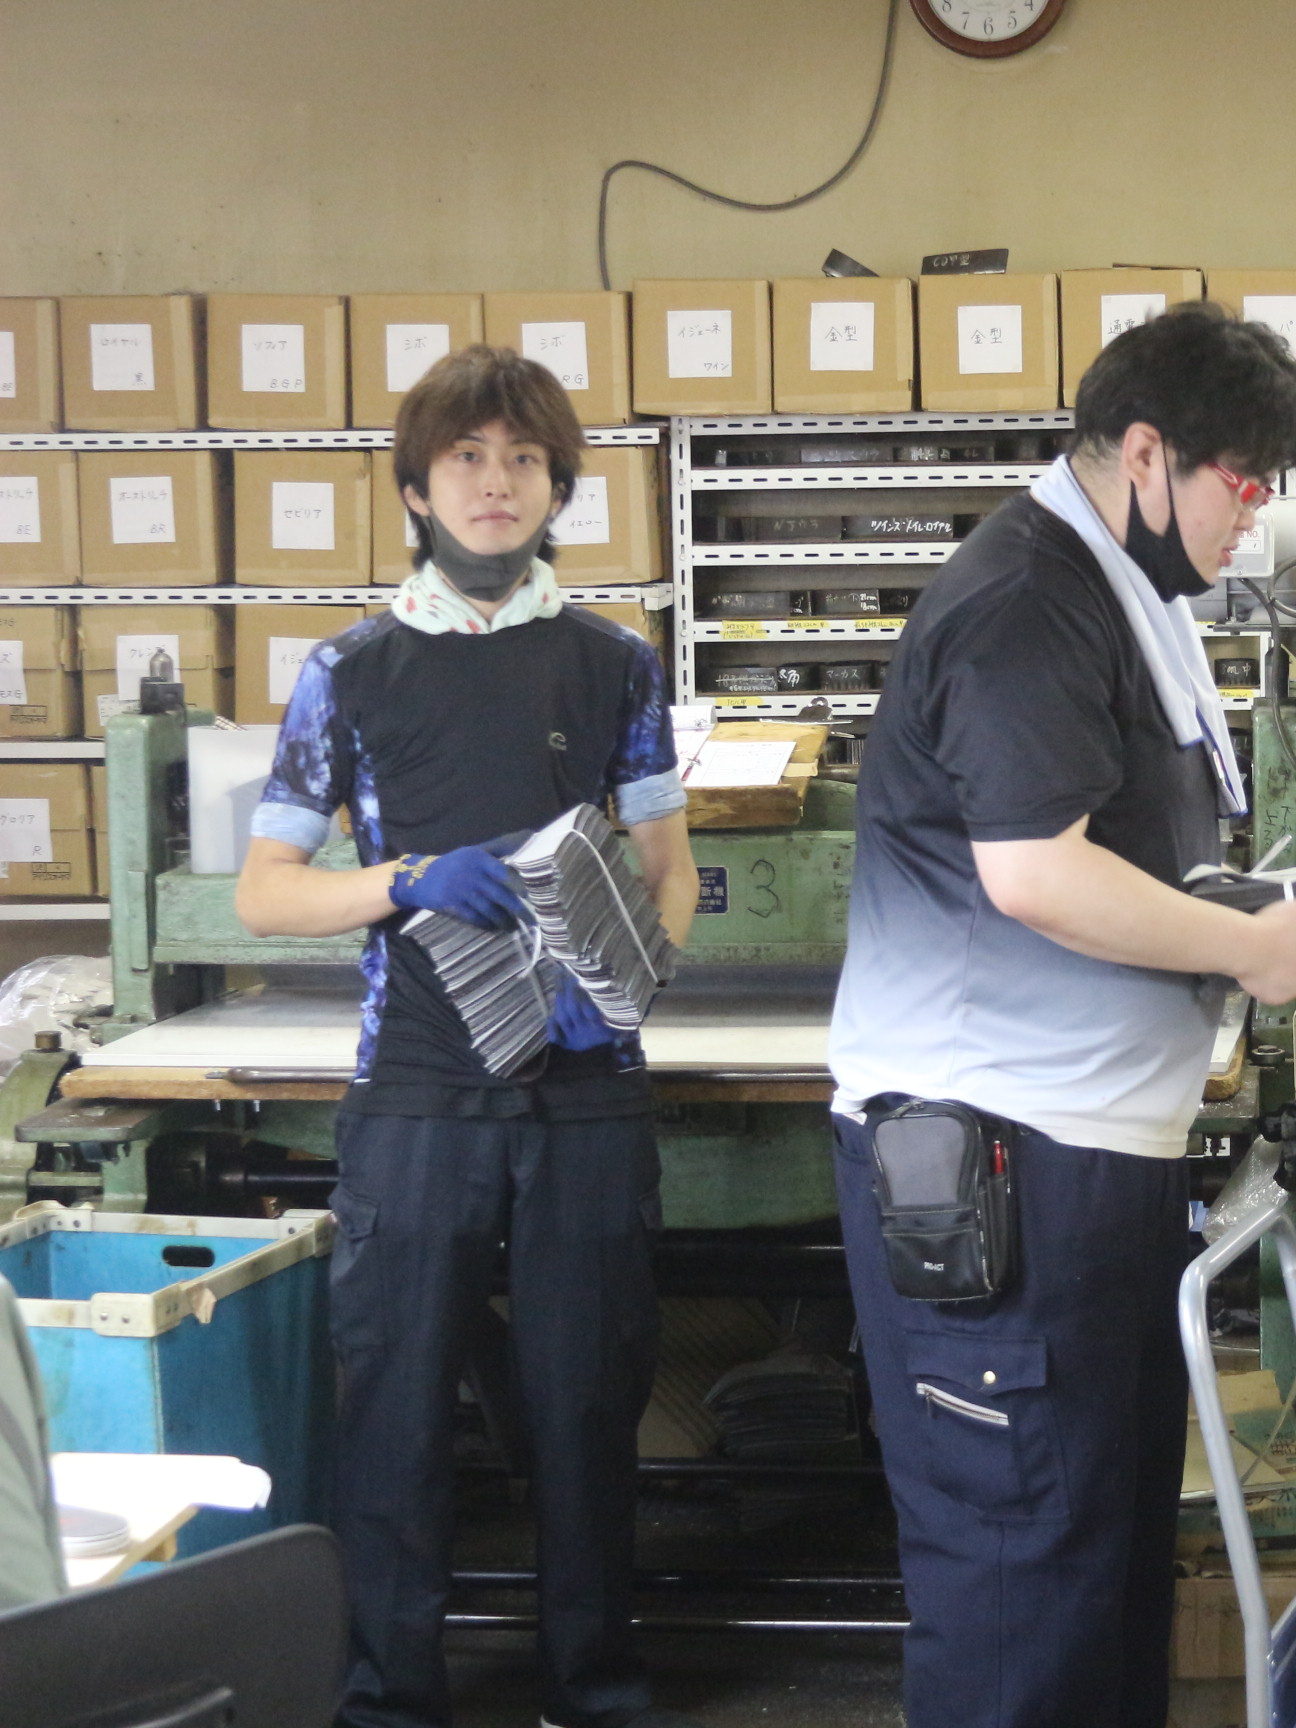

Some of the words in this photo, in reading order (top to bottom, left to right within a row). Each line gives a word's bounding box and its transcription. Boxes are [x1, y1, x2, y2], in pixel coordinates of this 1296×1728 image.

[961, 11, 970, 30] 7
[983, 16, 994, 36] 6
[1007, 11, 1017, 29] 5
[824, 325, 858, 343] 金型
[970, 327, 1003, 345] 金型
[746, 858, 780, 919] 3
